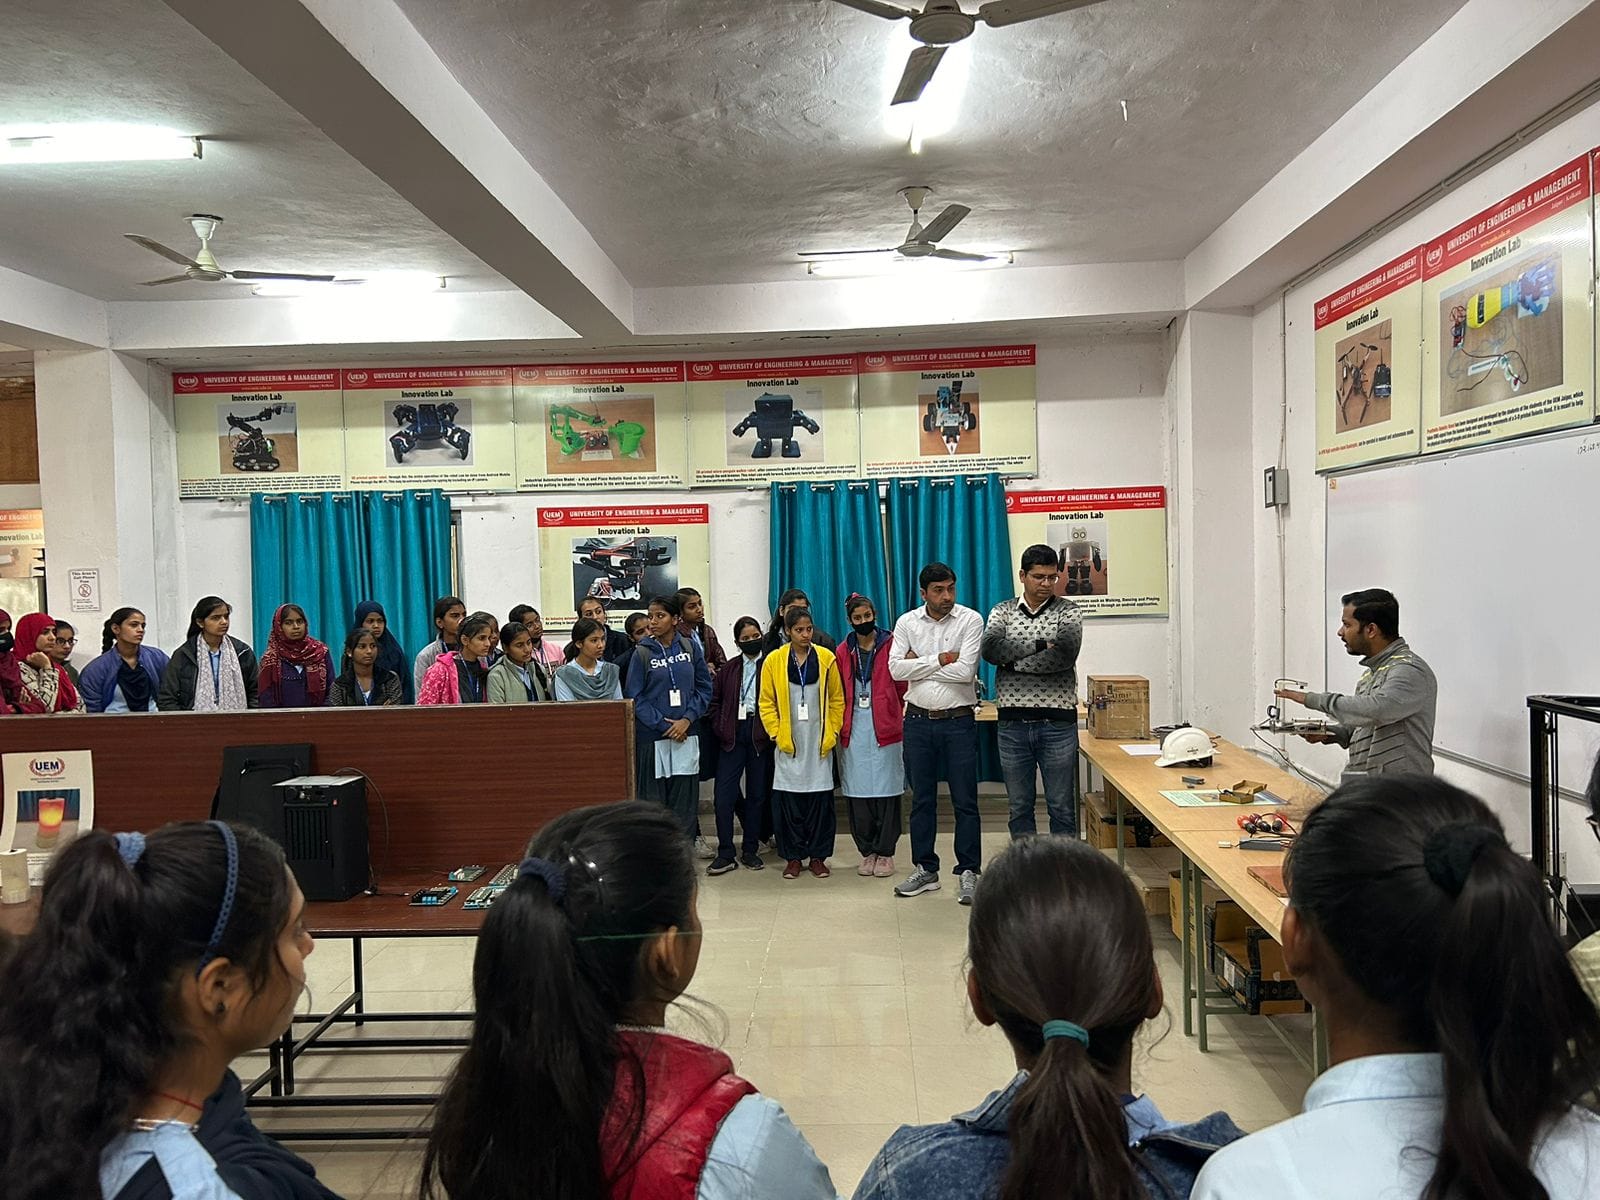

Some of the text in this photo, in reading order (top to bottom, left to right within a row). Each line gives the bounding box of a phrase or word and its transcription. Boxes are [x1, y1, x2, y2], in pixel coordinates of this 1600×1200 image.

[1447, 167, 1581, 251] UNIVERSITY OF ENGINEERING & MANAGEMENT
[1428, 248, 1441, 261] UEM
[1470, 237, 1521, 272] Innovation Lab
[1330, 292, 1351, 309] UNIVERSITY
[1351, 288, 1356, 298] OF
[1356, 274, 1382, 295] ENGINEERING
[1386, 255, 1417, 279] MANAGEMENT
[1345, 308, 1379, 331] Innovation Lab
[892, 354, 928, 362] UNIVERSITY
[939, 352, 979, 360] ENGINEERING
[987, 350, 1030, 358] MANAGEMENT
[719, 362, 753, 370] UNIVERSITY
[764, 361, 803, 369] ENGINEERING
[418, 370, 457, 378] ENGINEERING
[545, 369, 579, 377] UNIVERSITY
[921, 370, 975, 379] Innovation Lab
[203, 376, 237, 384] UNIVERSITY
[293, 373, 334, 381] MANAGEMENT
[401, 390, 439, 398] Innovation
[573, 385, 624, 394] Innovation Lab
[570, 510, 604, 518] UNIVERSITY
[650, 651, 691, 669] Superdry
[35, 761, 59, 770] UEM
